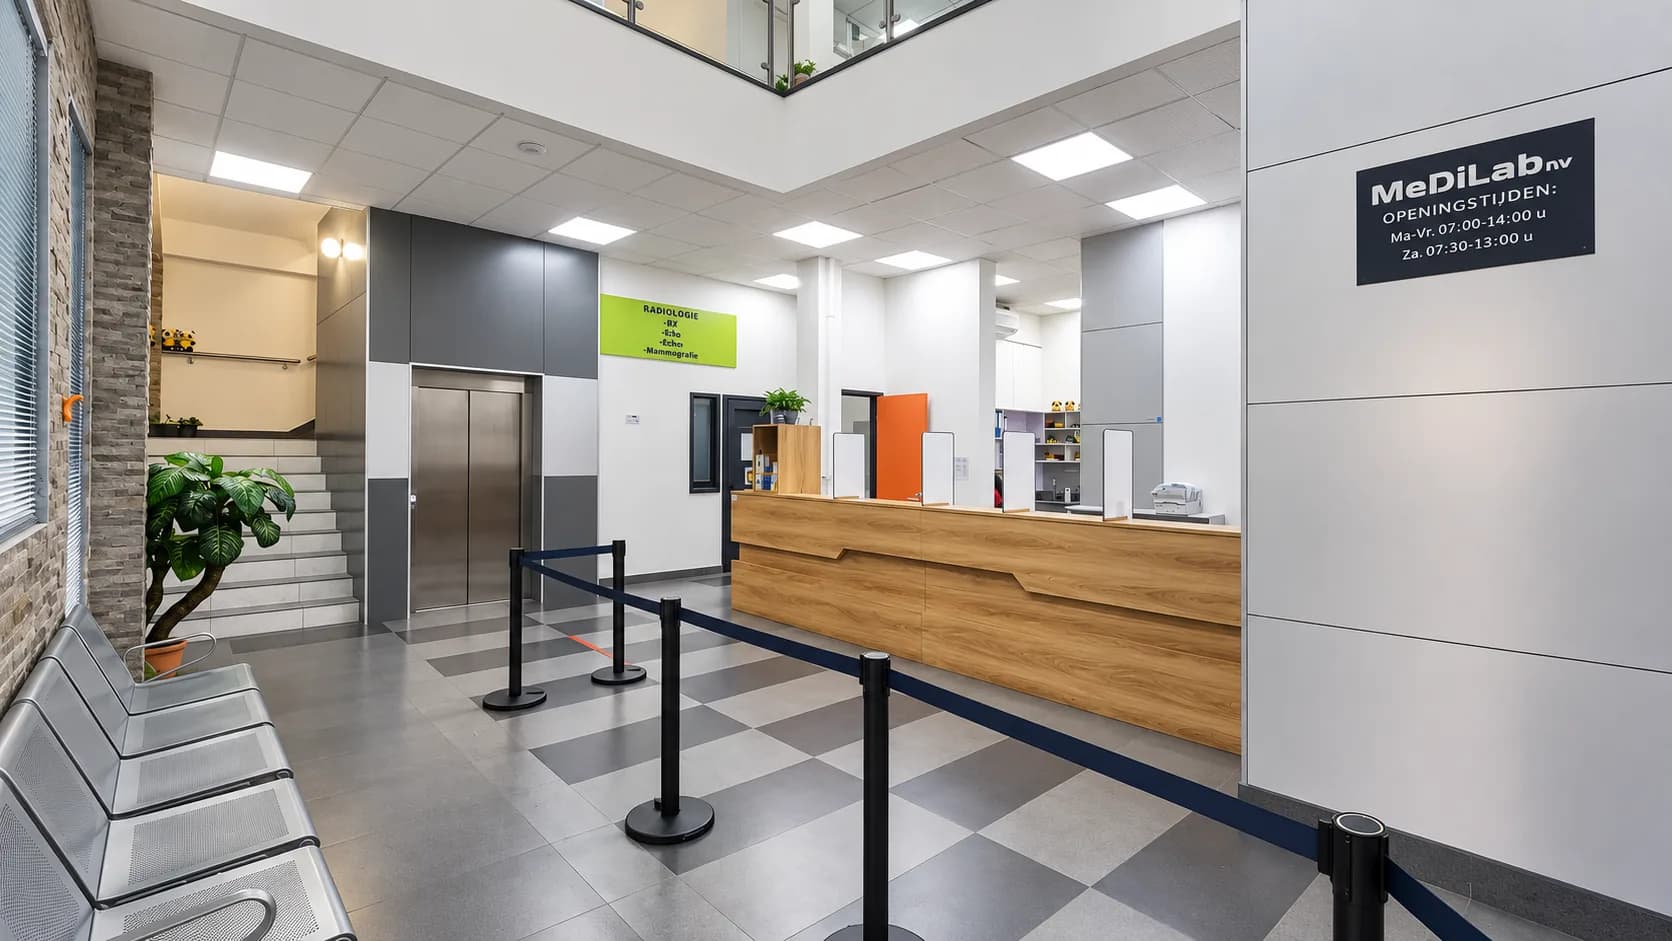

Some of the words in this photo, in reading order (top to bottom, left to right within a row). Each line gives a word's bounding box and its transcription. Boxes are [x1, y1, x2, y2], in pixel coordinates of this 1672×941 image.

[1383, 183, 1557, 224] OPENINGSTIJDEN:
[1391, 227, 1435, 244] Ma-Vr.
[1438, 210, 1532, 236] 07:00-14:00
[1537, 208, 1546, 218] u
[1402, 249, 1423, 261] Za.
[1426, 232, 1519, 257] 07:30-13:00
[1524, 232, 1533, 242] u
[643, 305, 699, 320] RADIOLOGIE
